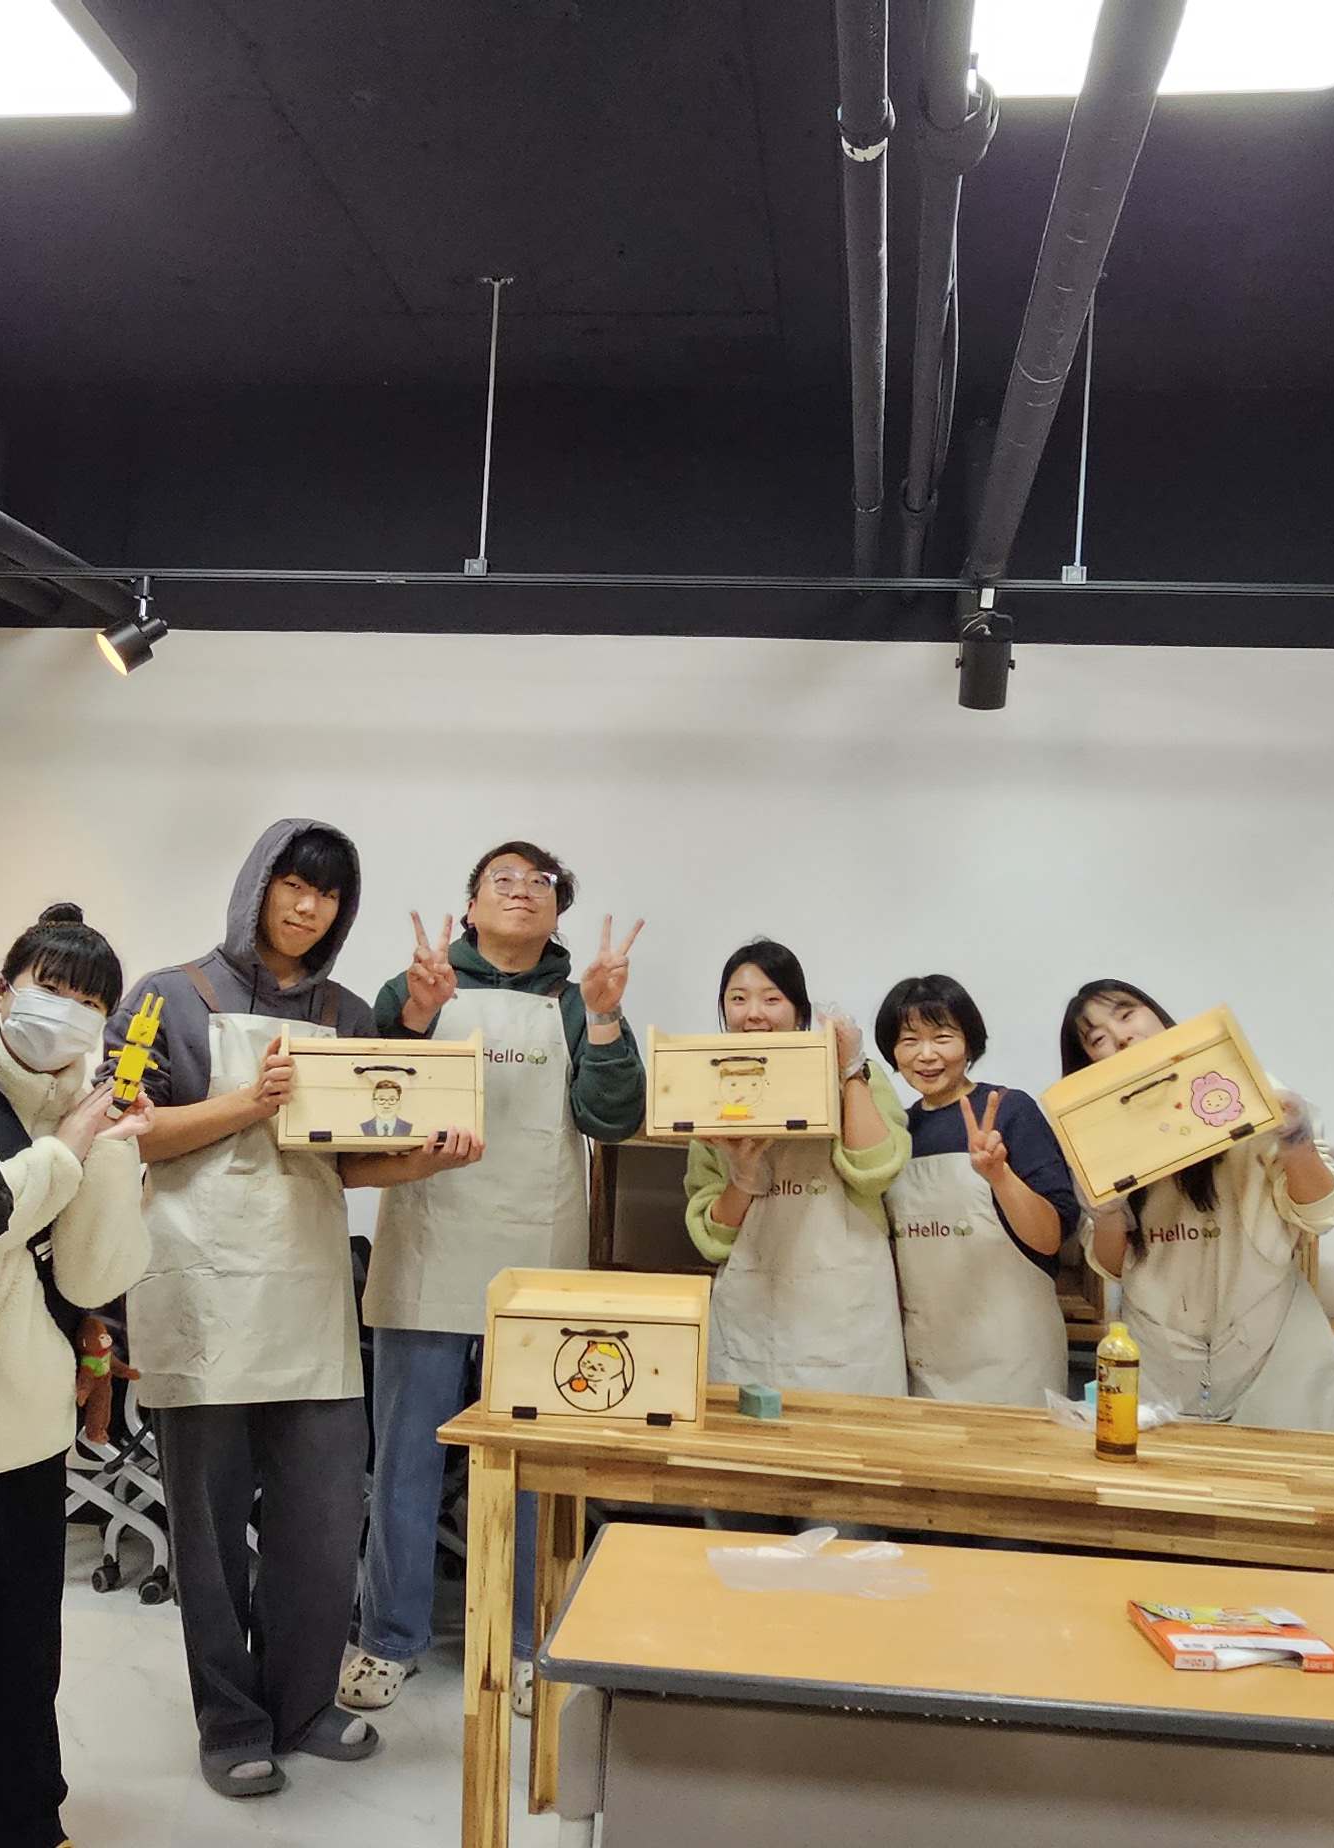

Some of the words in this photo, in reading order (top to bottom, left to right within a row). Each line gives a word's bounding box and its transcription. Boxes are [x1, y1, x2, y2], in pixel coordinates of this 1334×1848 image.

[770, 1179, 802, 1196] ello
[908, 1221, 950, 1238] Hello
[1149, 1223, 1199, 1243] Hello
